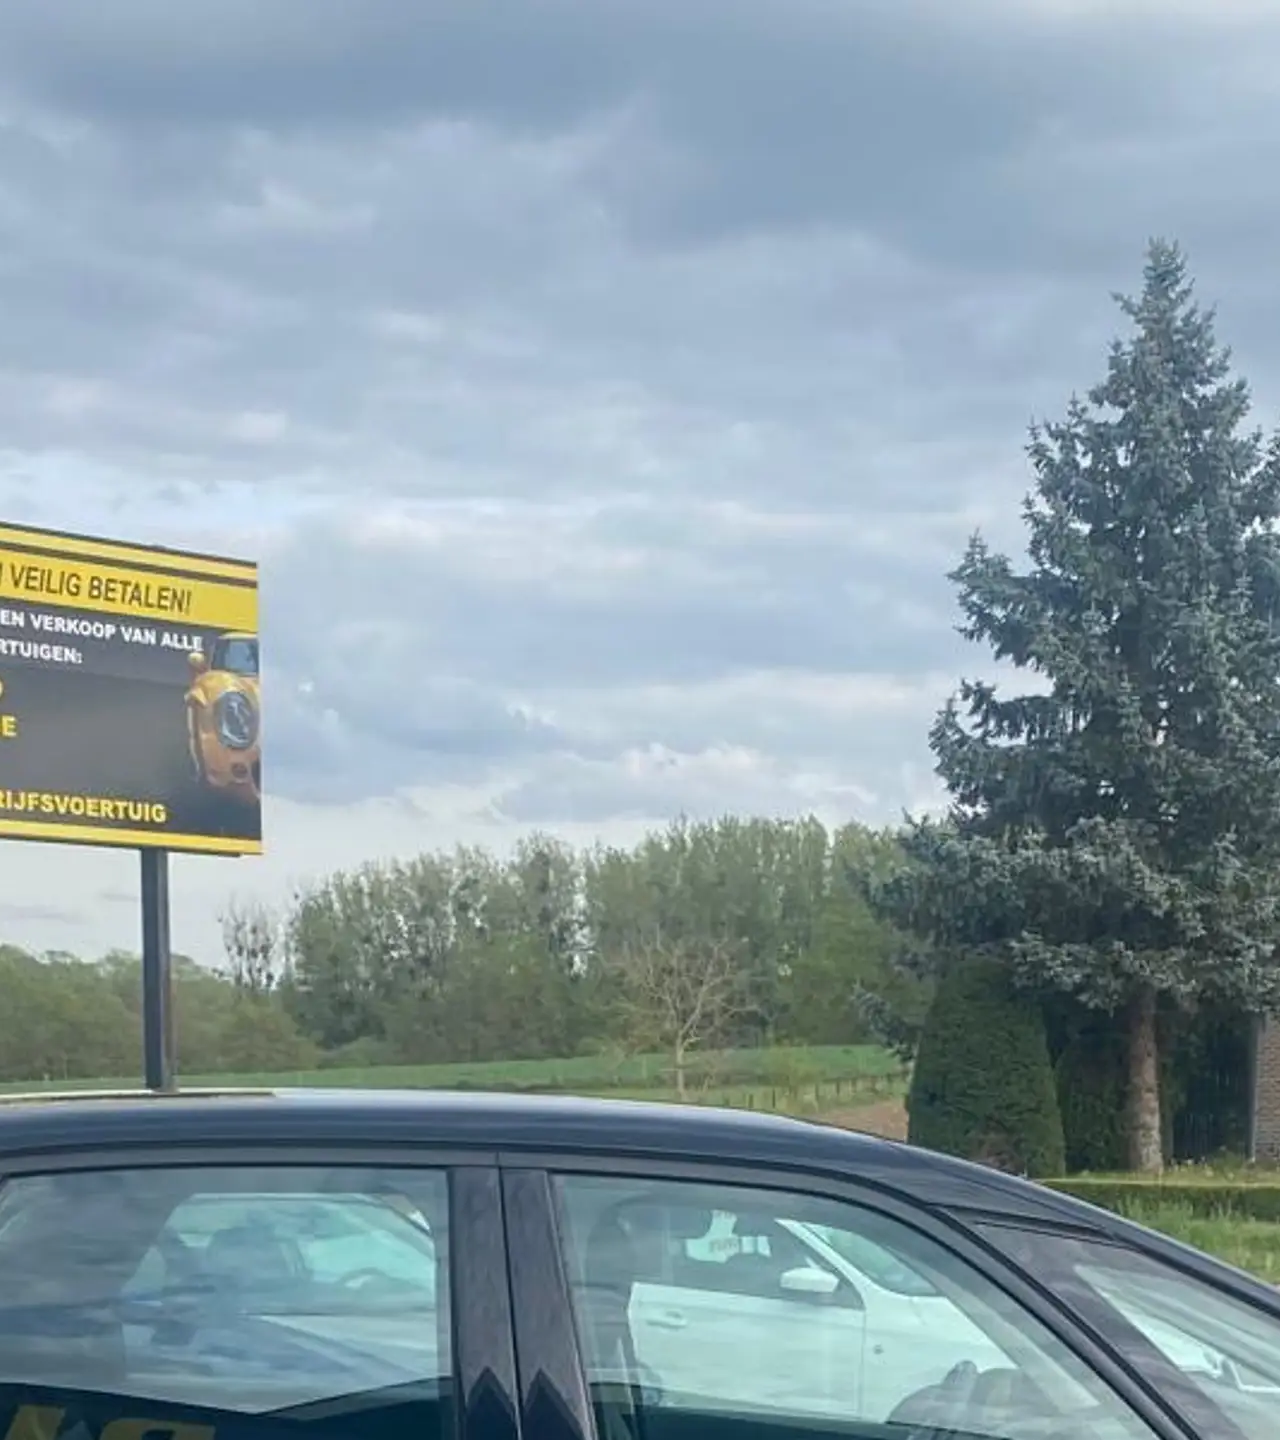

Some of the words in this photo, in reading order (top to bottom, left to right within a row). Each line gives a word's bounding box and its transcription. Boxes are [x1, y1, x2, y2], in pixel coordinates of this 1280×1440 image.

[10, 561, 82, 598] VEILIG
[87, 575, 193, 615] BETALEN!
[0, 609, 25, 628] EN
[30, 612, 116, 641] VERKOOP
[120, 625, 157, 646] VAN
[160, 631, 205, 652] ALLE
